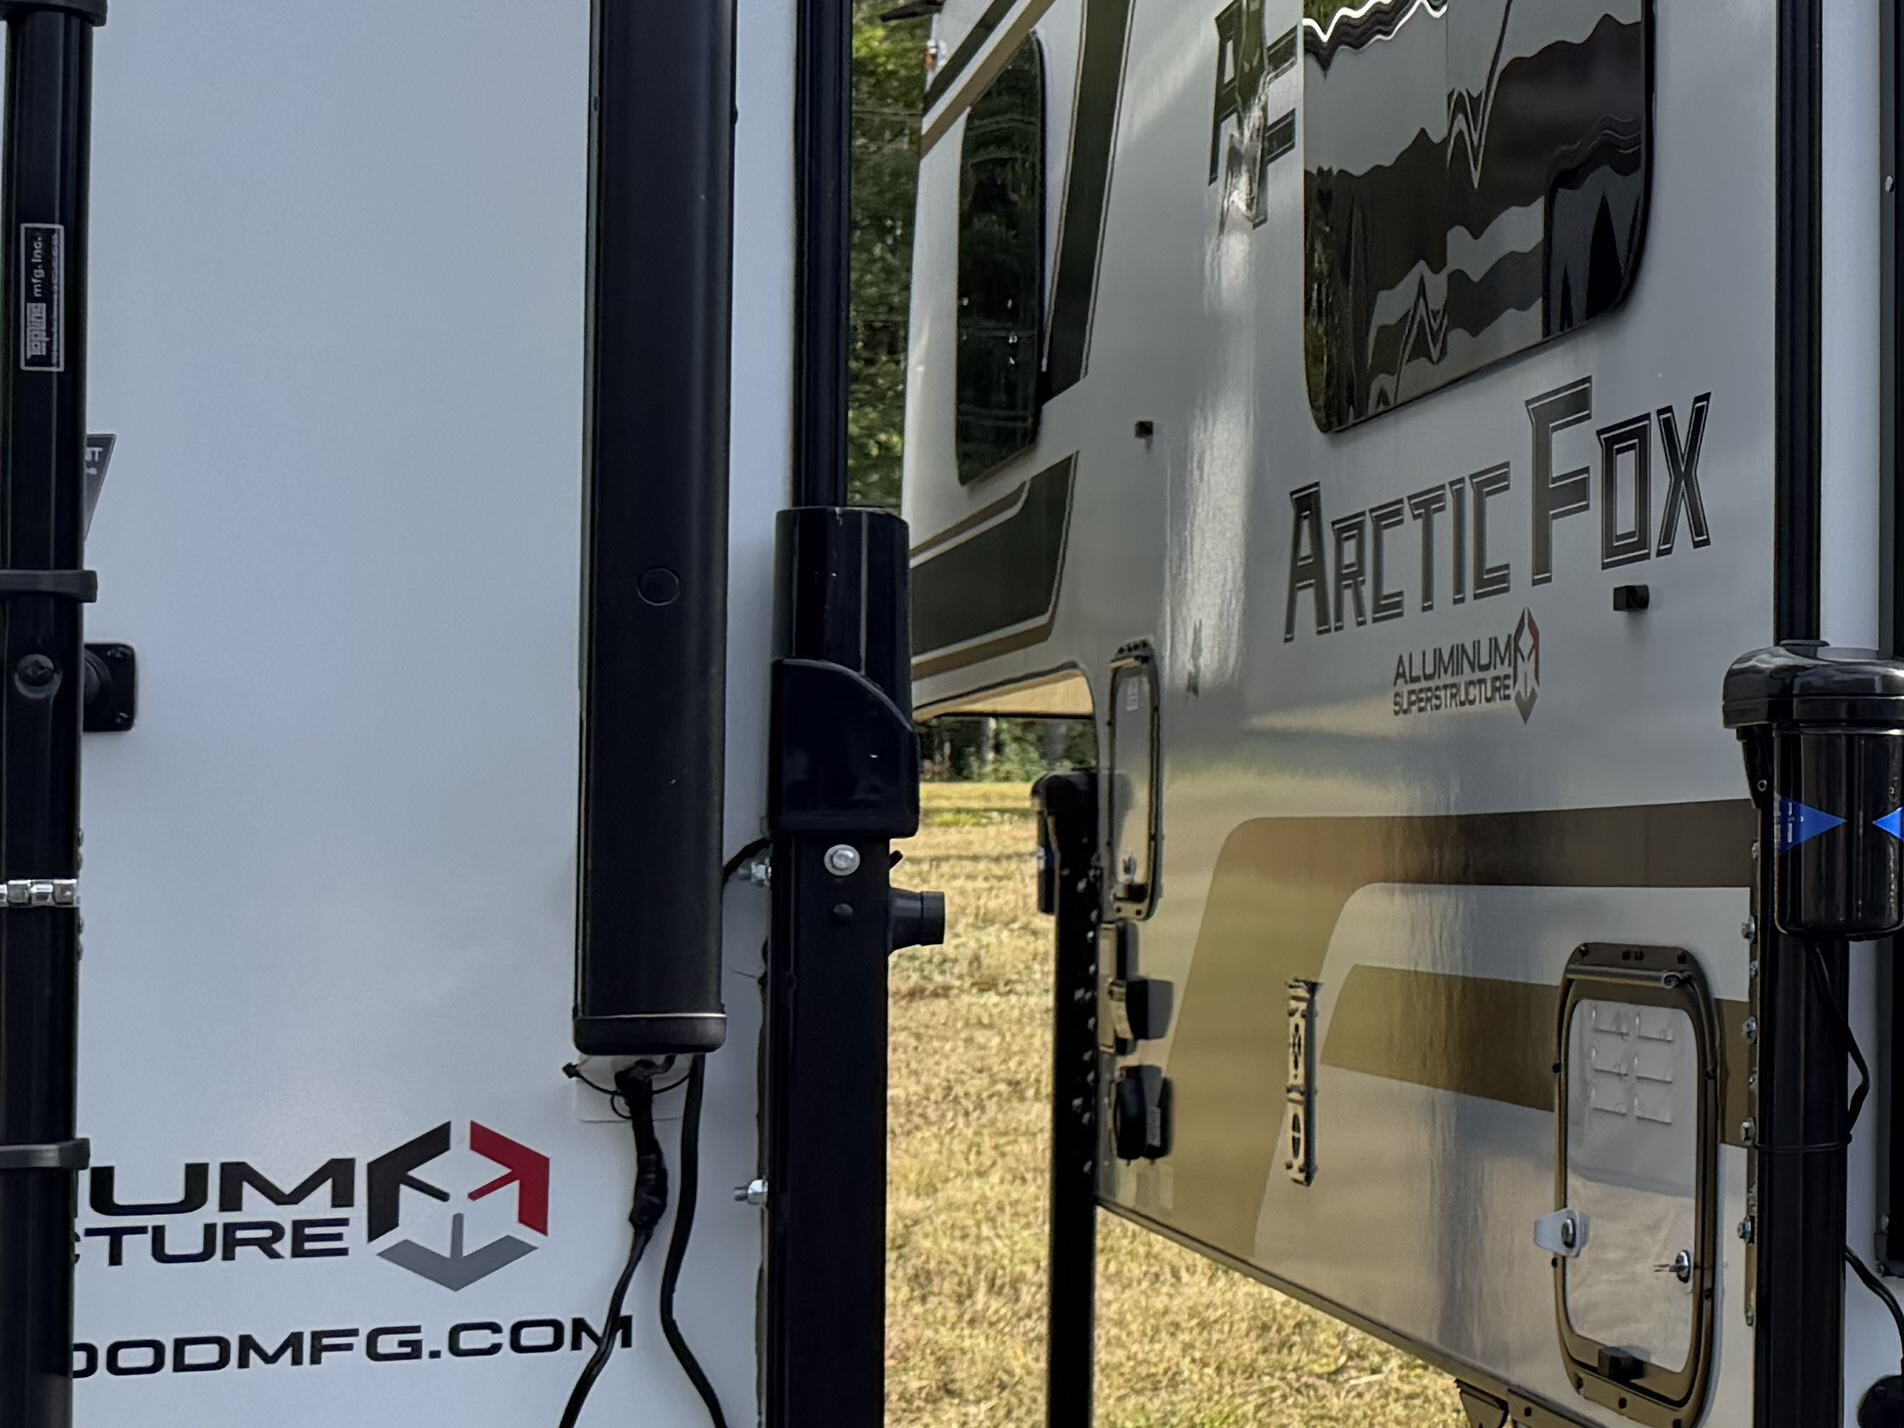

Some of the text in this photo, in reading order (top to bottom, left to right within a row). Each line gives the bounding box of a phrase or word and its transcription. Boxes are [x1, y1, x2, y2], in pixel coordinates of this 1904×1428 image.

[1283, 374, 1712, 644] ARCTIC FOX
[1392, 634, 1513, 687] ALUMINUM
[1392, 674, 1512, 716] SUPERSTRUCTURE
